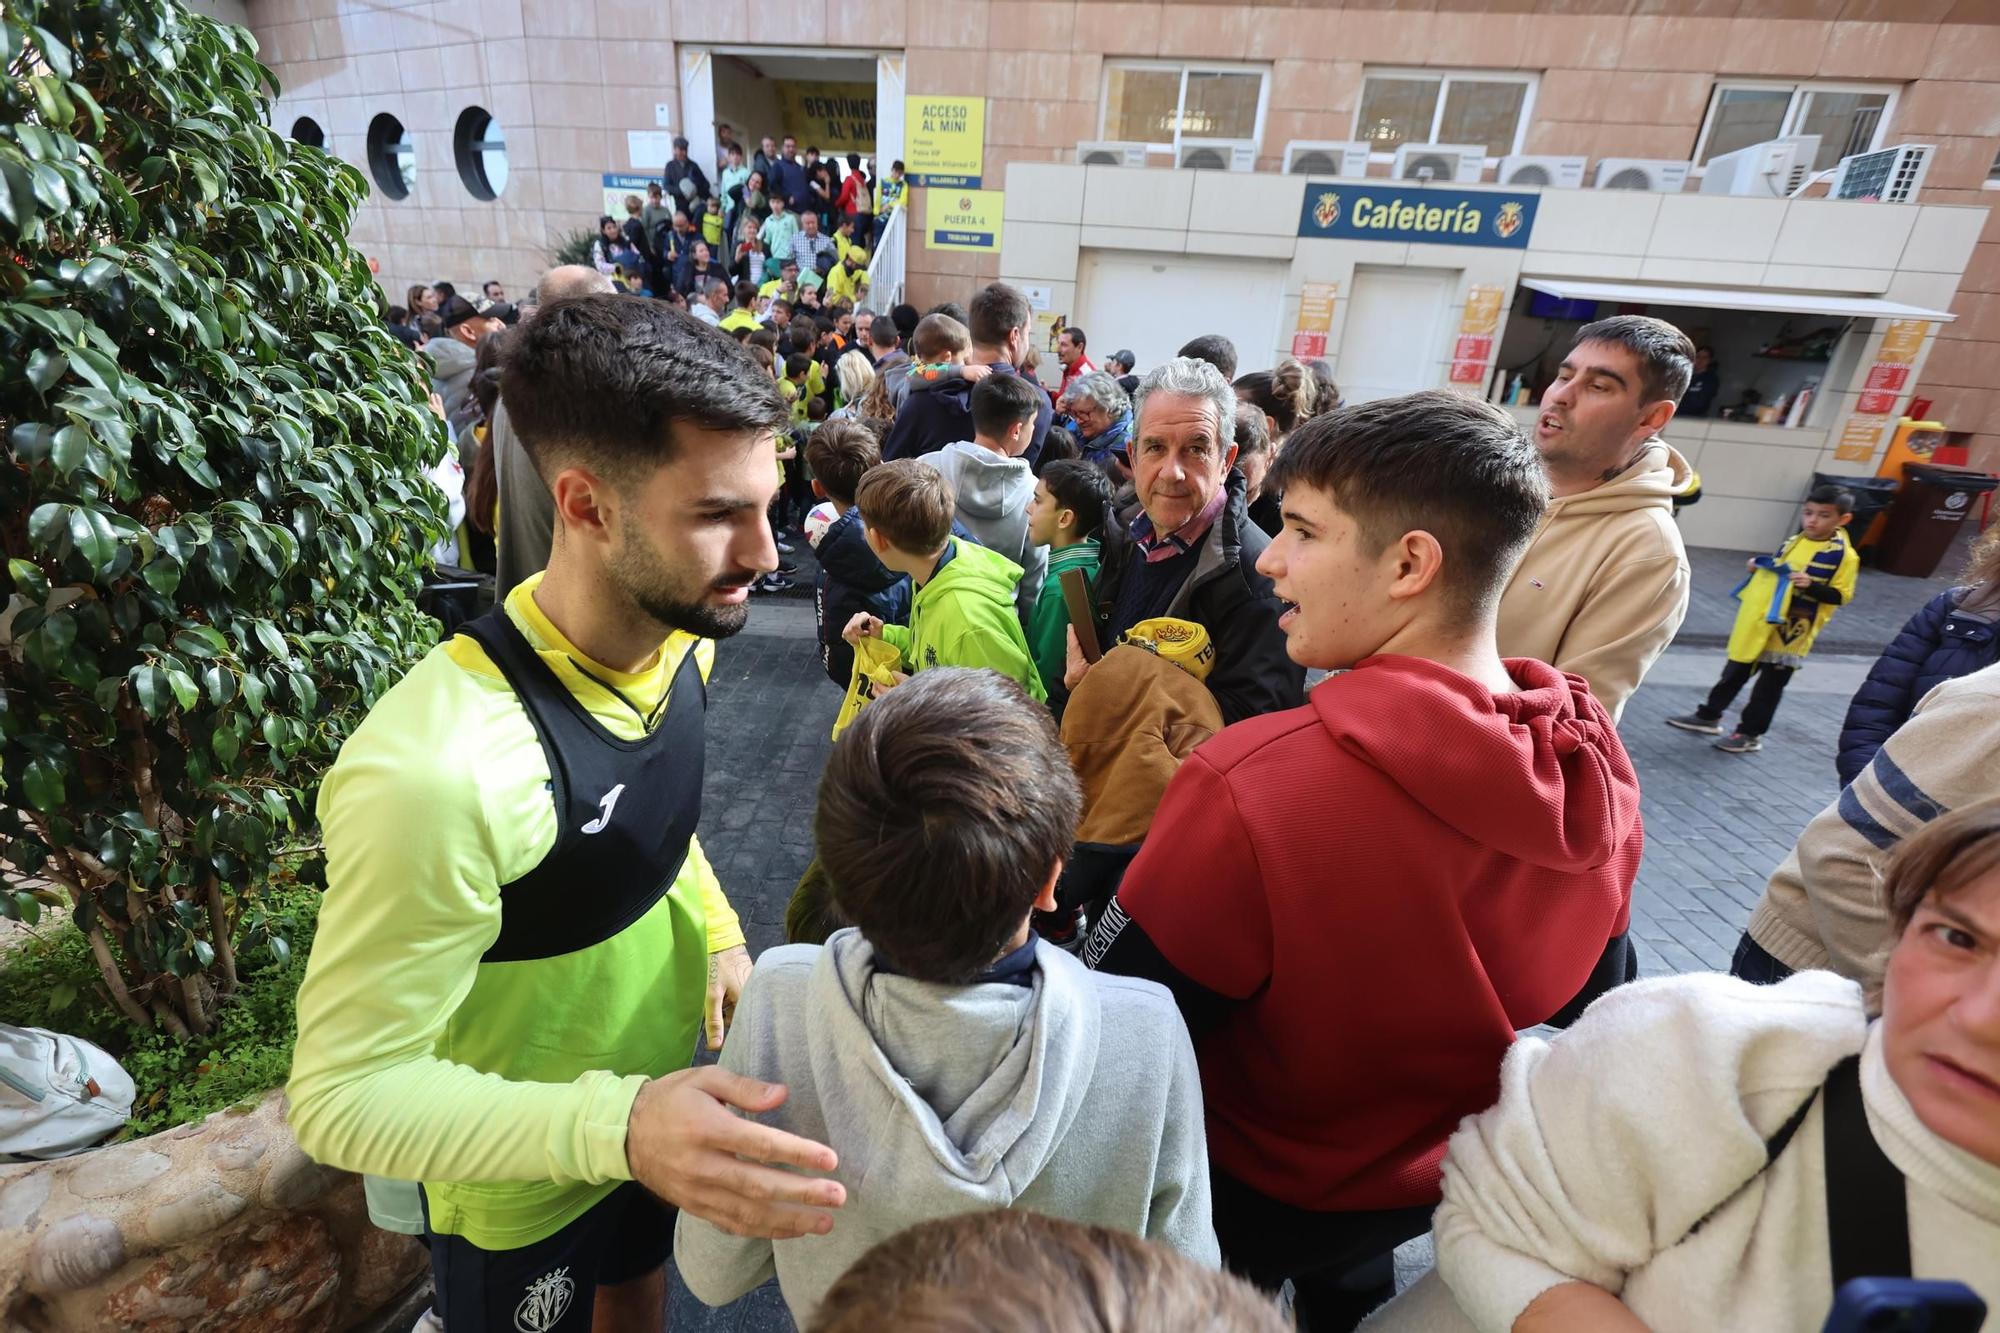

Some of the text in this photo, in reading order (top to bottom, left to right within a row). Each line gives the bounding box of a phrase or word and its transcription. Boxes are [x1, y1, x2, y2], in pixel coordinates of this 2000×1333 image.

[922, 104, 967, 118] ACCESO
[828, 120, 847, 139] AL
[922, 120, 966, 132] AL MINI
[944, 215, 986, 226] PUERTA 4
[1351, 197, 1482, 234] Cafetería
